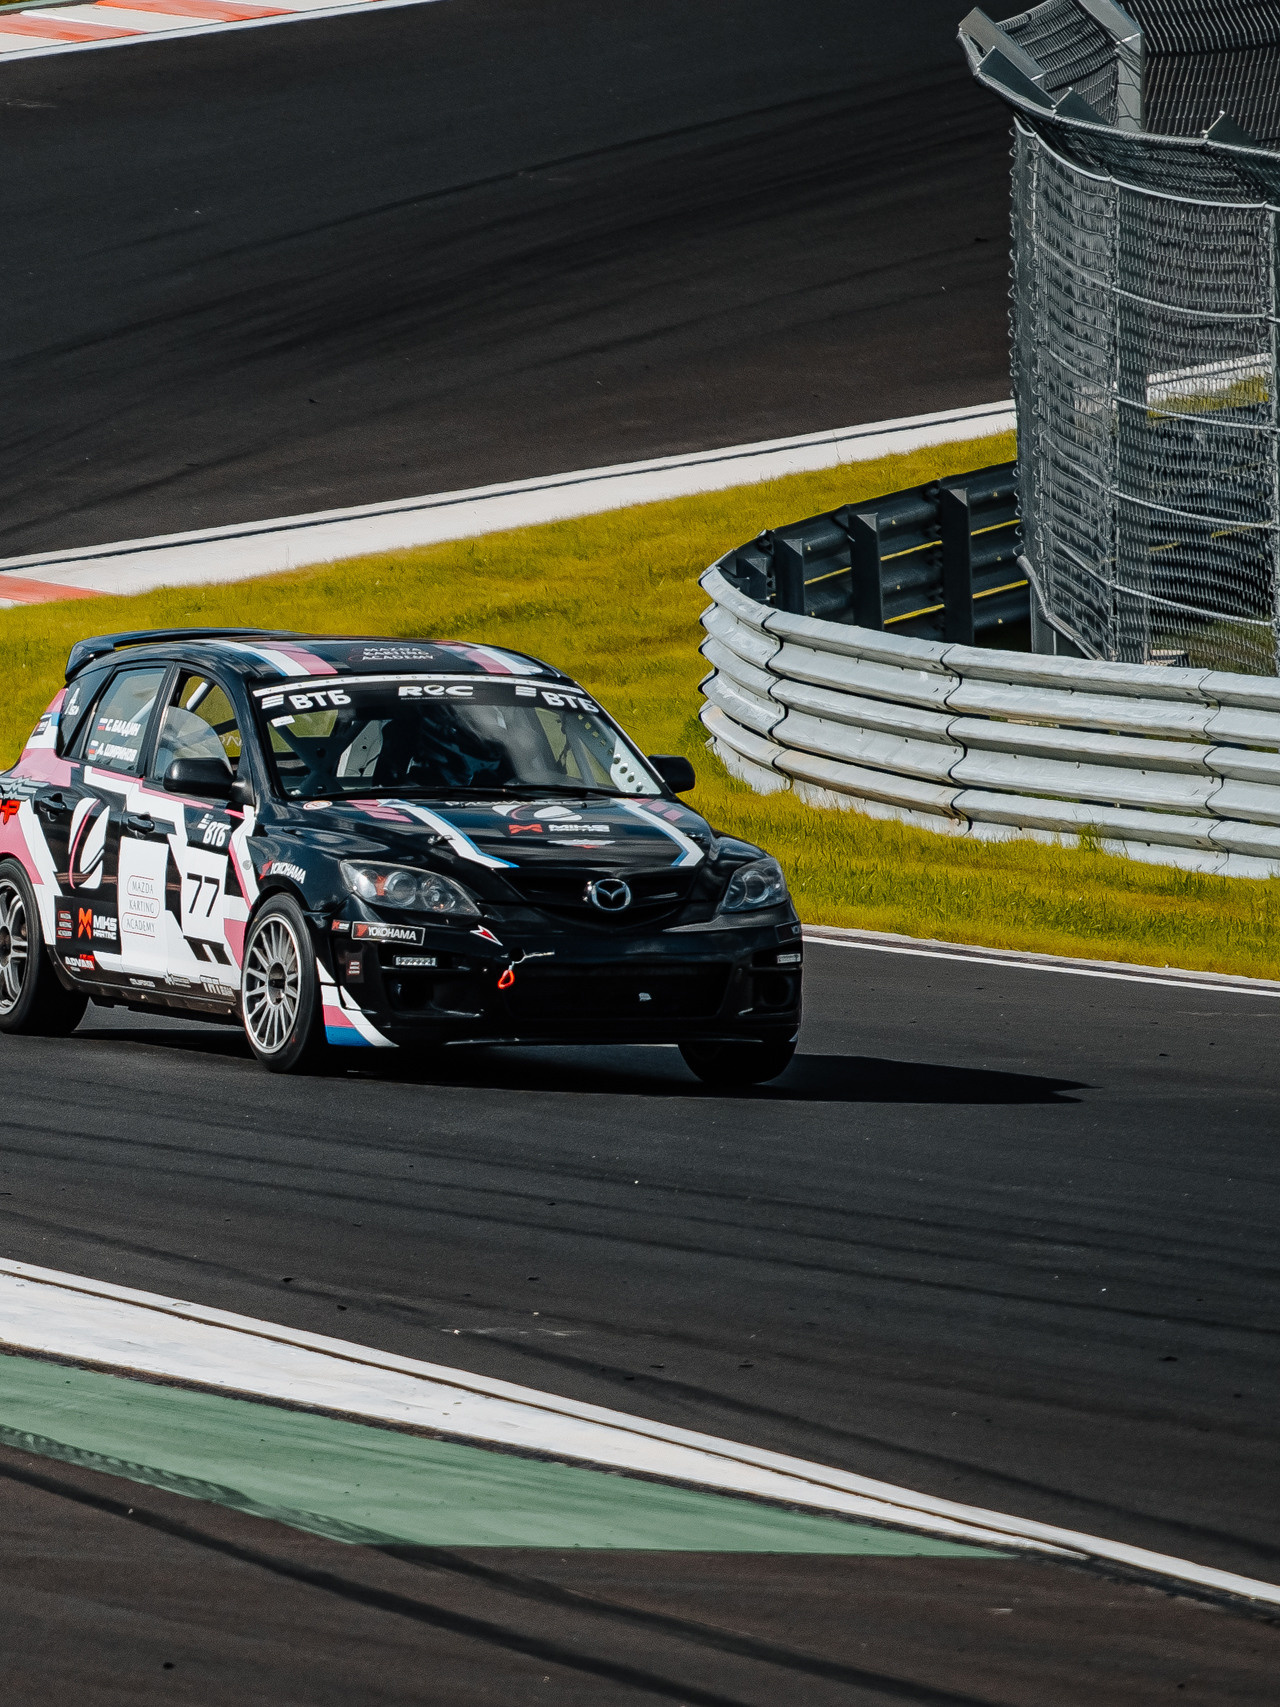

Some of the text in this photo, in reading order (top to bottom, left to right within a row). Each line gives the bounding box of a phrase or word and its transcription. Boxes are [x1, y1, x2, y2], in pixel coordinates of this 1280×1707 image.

[289, 689, 351, 709] ВТБ
[541, 691, 600, 713] ВТБ
[202, 821, 232, 847] ВТБ
[270, 862, 306, 884] YOKOHAMA
[131, 881, 154, 895] MAZDA
[186, 872, 221, 918] 77
[128, 899, 155, 914] KARTING
[126, 918, 155, 933] ACADEMY
[368, 926, 417, 941] YOKOHAMA
